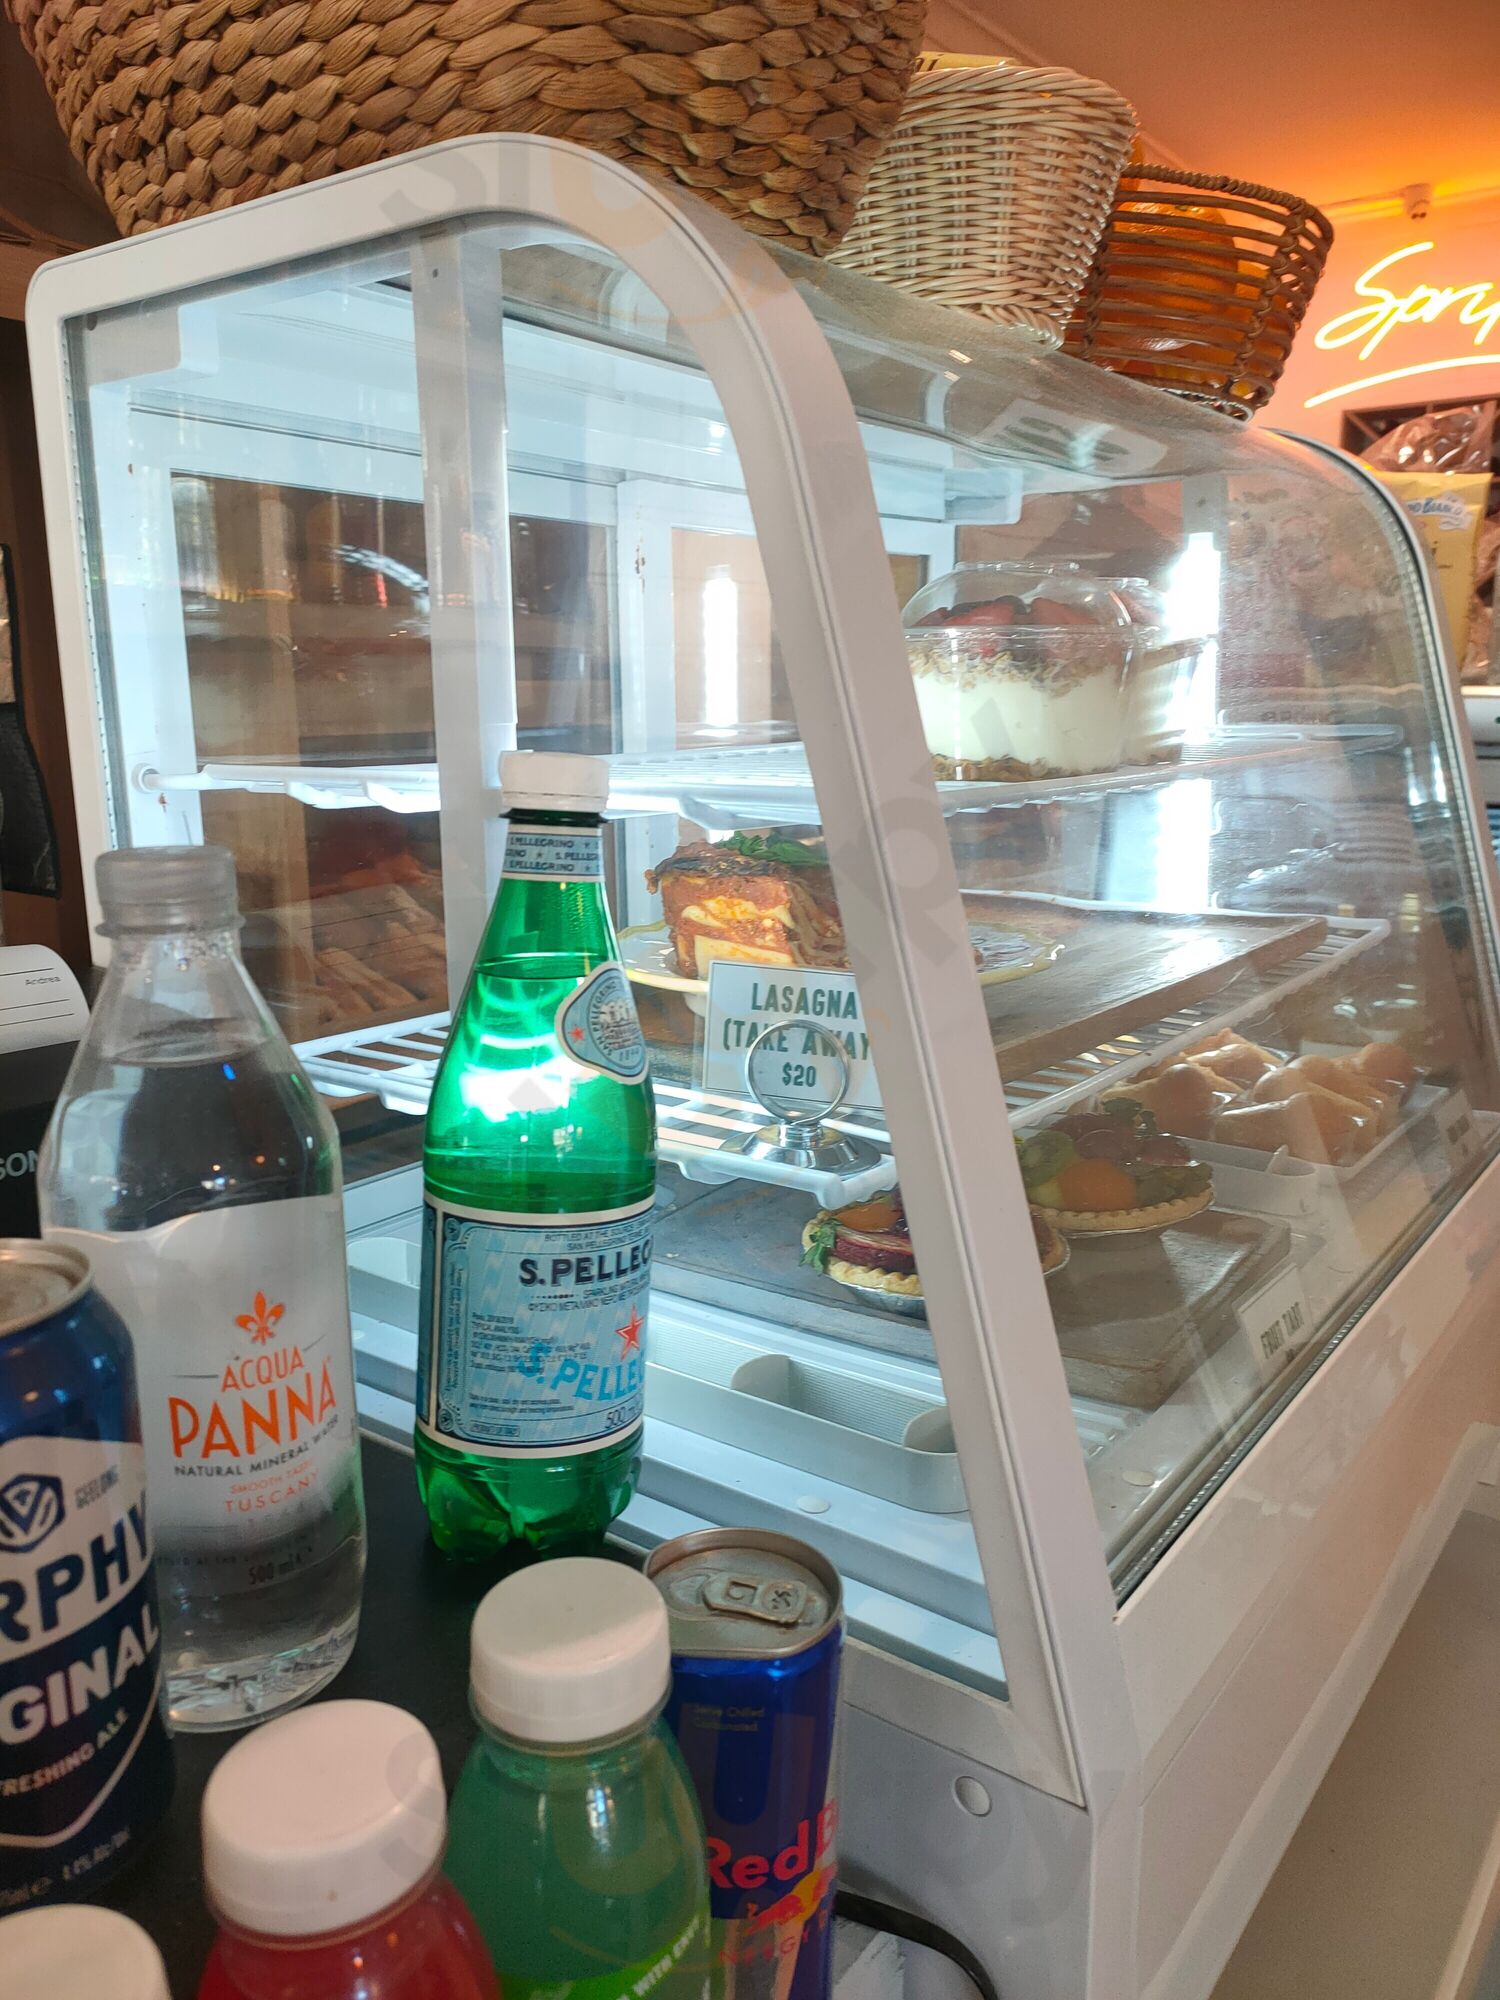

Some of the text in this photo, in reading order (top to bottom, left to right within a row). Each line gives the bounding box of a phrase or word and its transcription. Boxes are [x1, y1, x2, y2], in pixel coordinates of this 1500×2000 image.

[25, 976, 62, 986] Andrea
[752, 982, 858, 1020] LASAGNA
[723, 1017, 789, 1053] (TAKE
[782, 1062, 817, 1087] $20
[221, 1345, 304, 1393] ACQUA
[516, 1342, 644, 1401] S.PELLE
[168, 1361, 337, 1459] PANNA
[174, 1464, 243, 1478] NATURAL
[250, 1441, 310, 1473] MINERAL
[225, 1469, 319, 1513] TUSCANY
[249, 1561, 275, 1585] 500
[0, 1603, 159, 1745] GINAL
[97, 1706, 129, 1749] ALE
[706, 1819, 810, 1889] Red
